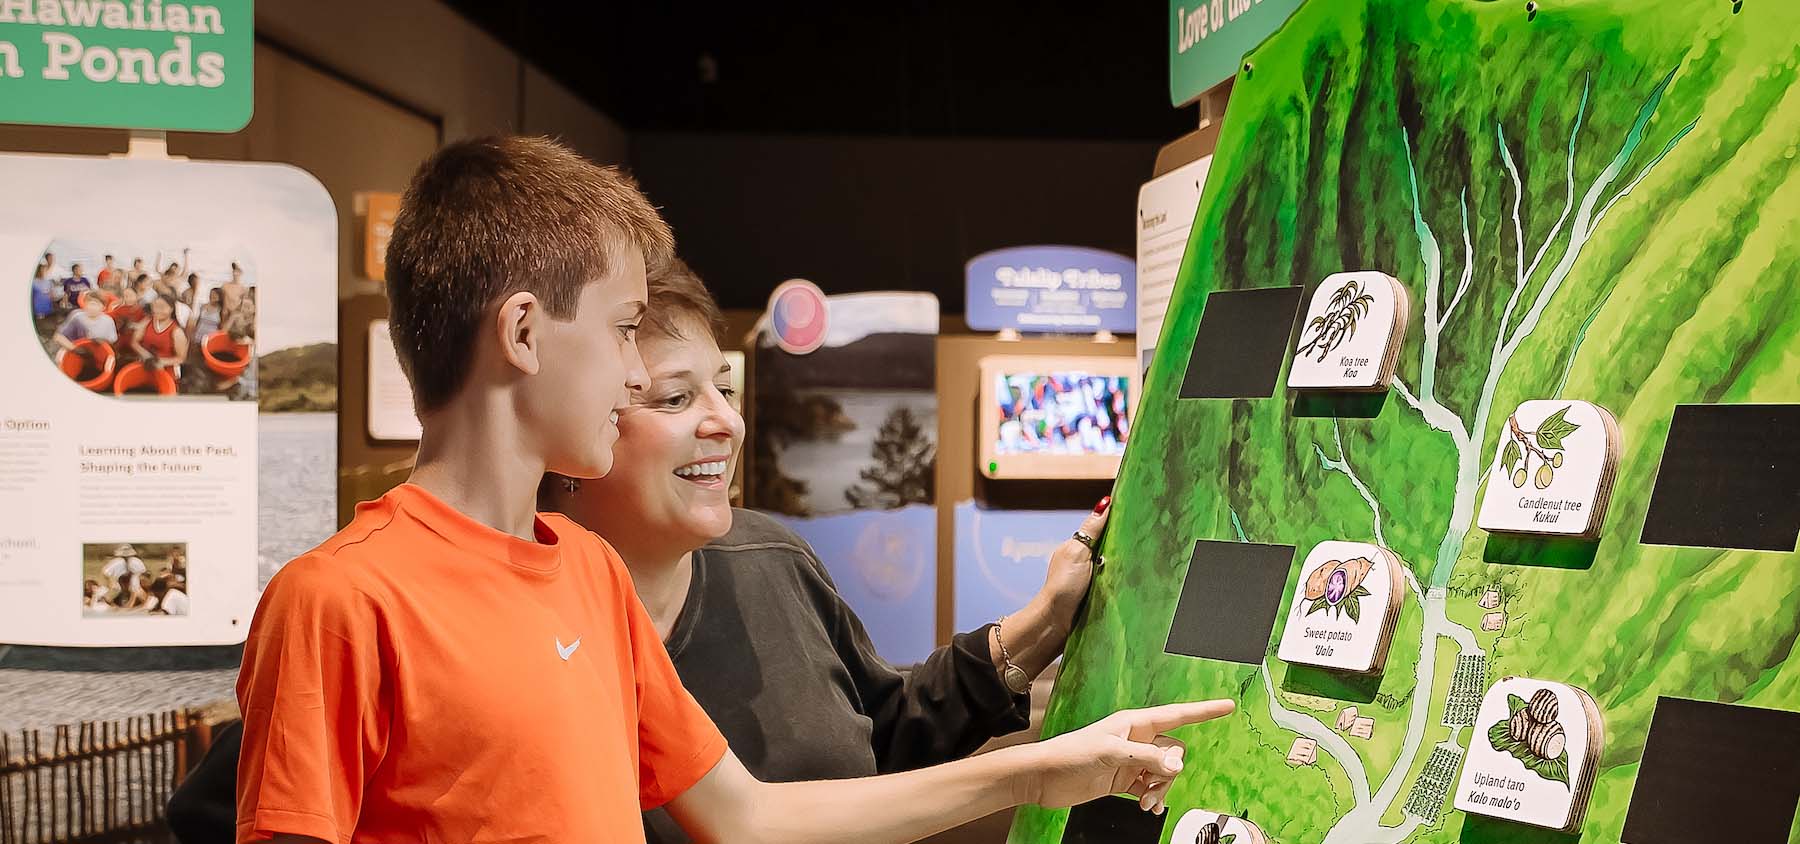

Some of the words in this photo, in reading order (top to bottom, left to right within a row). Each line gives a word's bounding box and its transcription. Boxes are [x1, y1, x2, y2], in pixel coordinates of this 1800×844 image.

[1178, 4, 1208, 54] Love
[42, 31, 225, 88] Ponds
[1340, 356, 1353, 366] Koa
[1354, 356, 1368, 367] tree
[80, 445, 136, 457] Learning
[140, 445, 177, 456] About
[1518, 497, 1563, 510] Candlenut
[1564, 500, 1581, 511] tree
[1532, 511, 1560, 523] Kukui
[1304, 627, 1327, 639] Sweet
[1327, 630, 1352, 642] potato
[1474, 772, 1507, 787] Upland
[1507, 778, 1525, 791] taro
